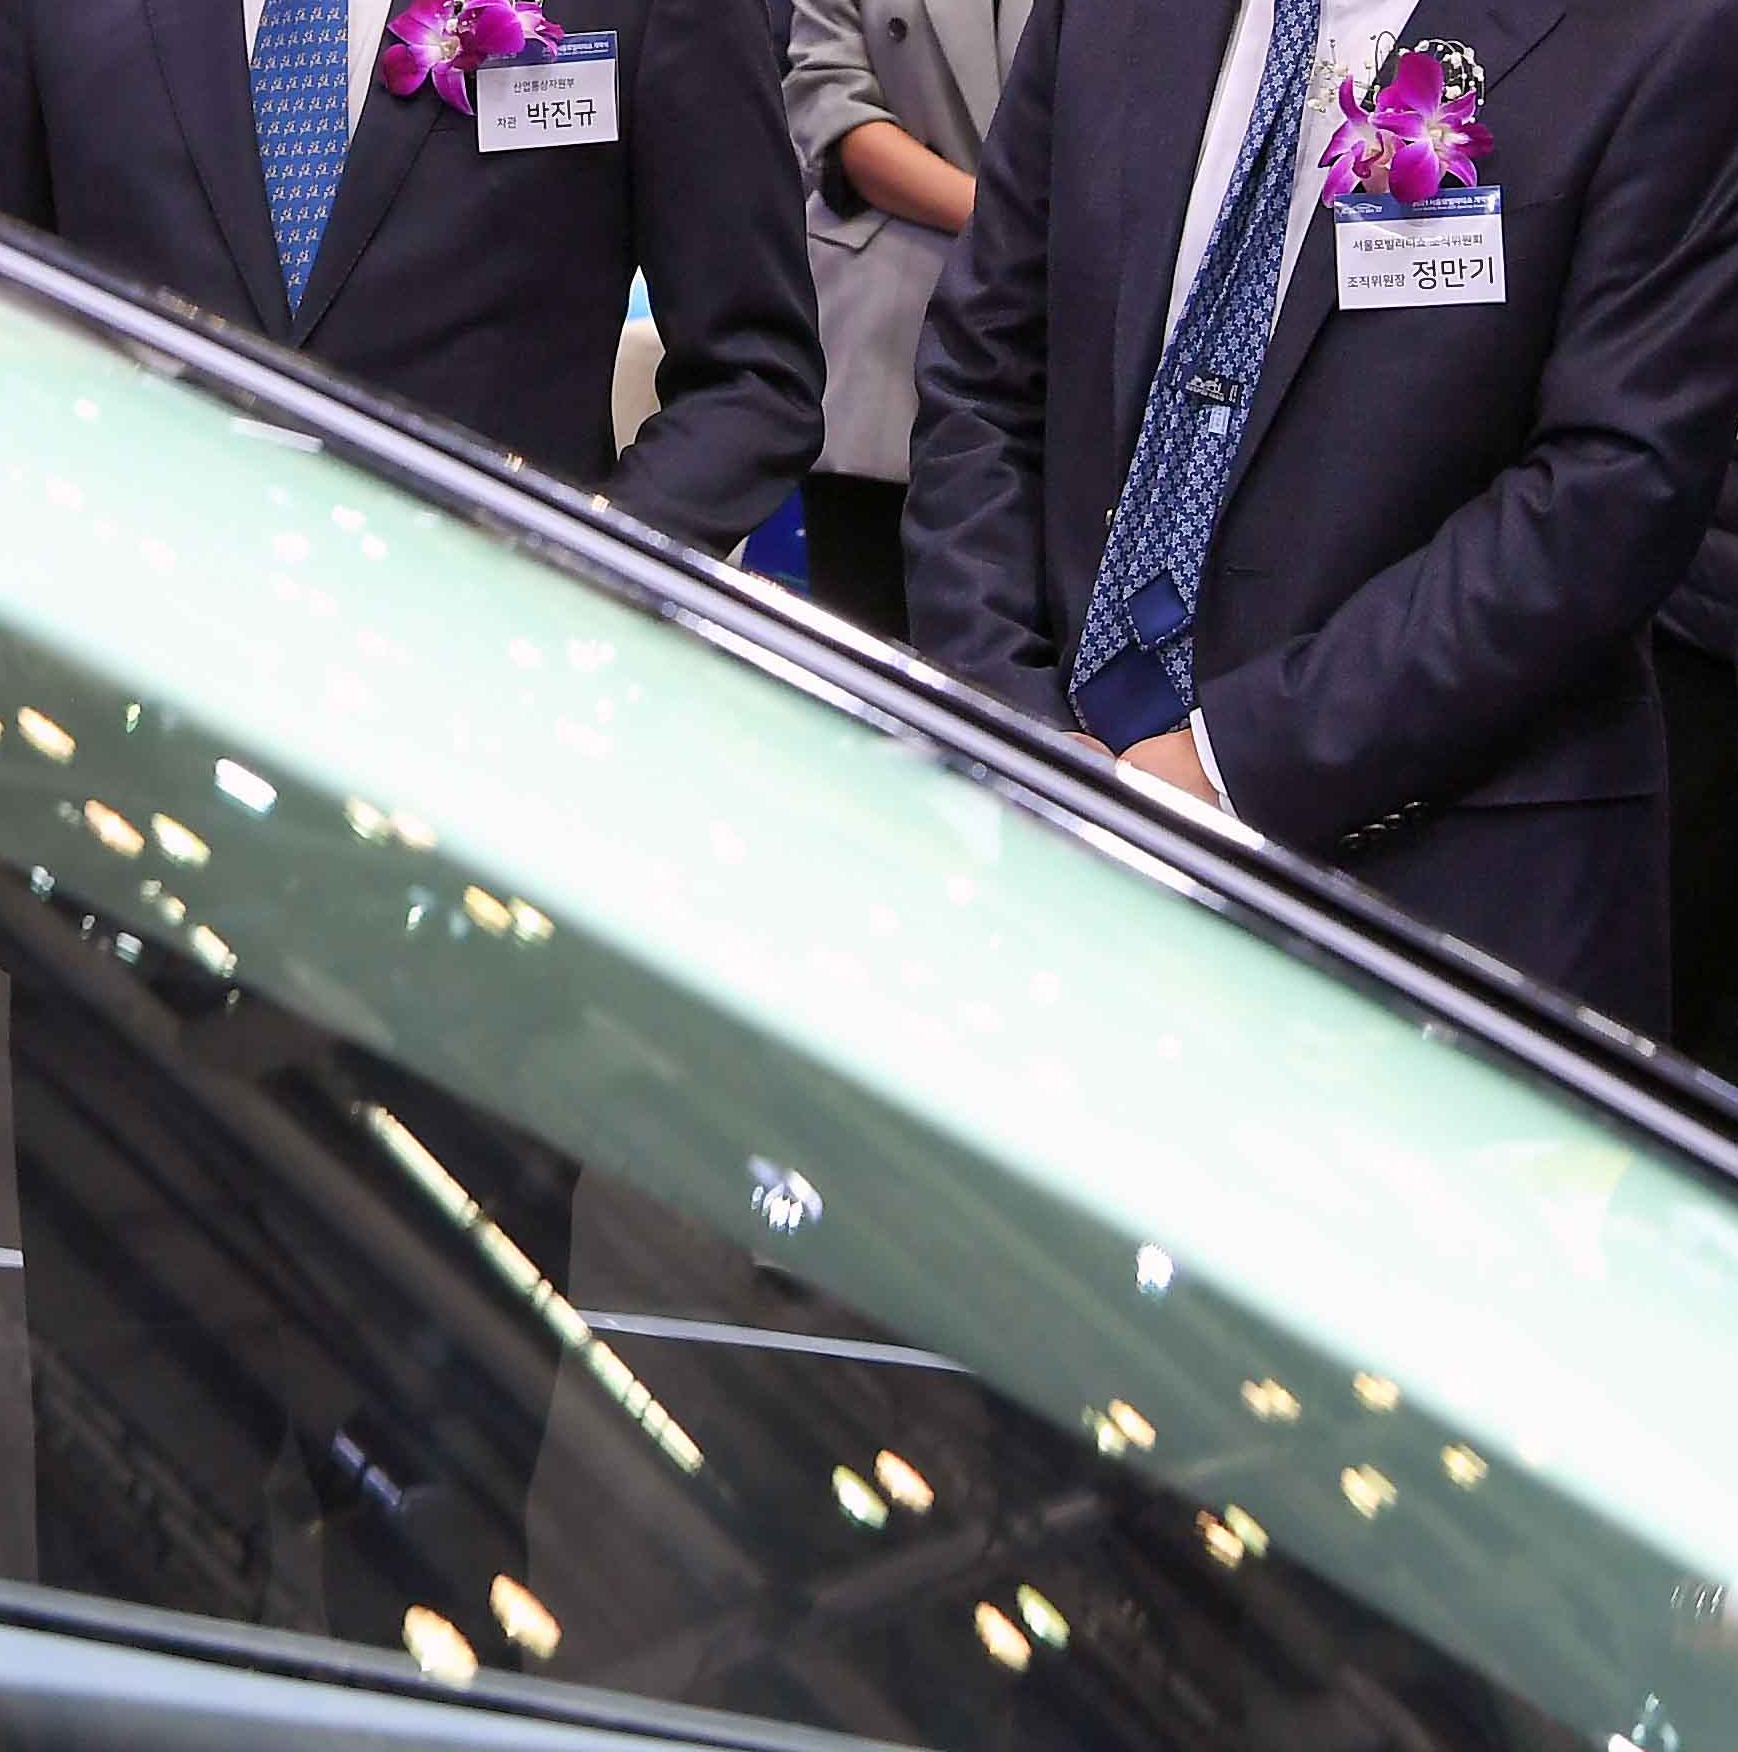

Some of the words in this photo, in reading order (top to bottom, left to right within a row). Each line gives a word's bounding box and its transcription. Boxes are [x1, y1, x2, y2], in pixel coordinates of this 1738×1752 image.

[527, 99, 597, 130] 박진규
[1347, 273, 1406, 289] 조직위원장
[1412, 256, 1495, 290] 정만기
